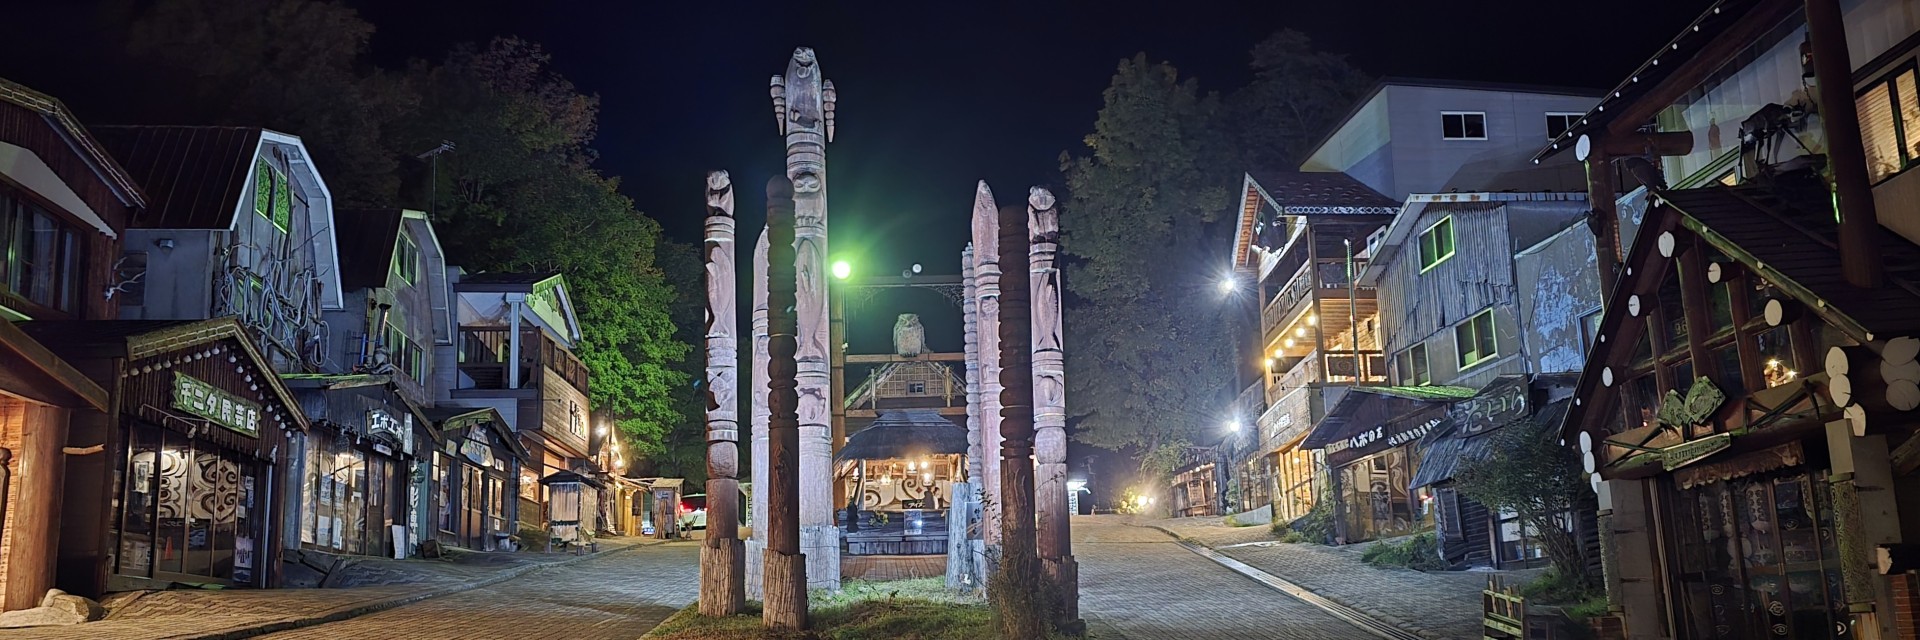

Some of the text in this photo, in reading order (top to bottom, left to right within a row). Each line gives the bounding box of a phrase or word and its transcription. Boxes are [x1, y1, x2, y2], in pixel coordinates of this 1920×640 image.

[180, 382, 256, 431] チニタ民芸店
